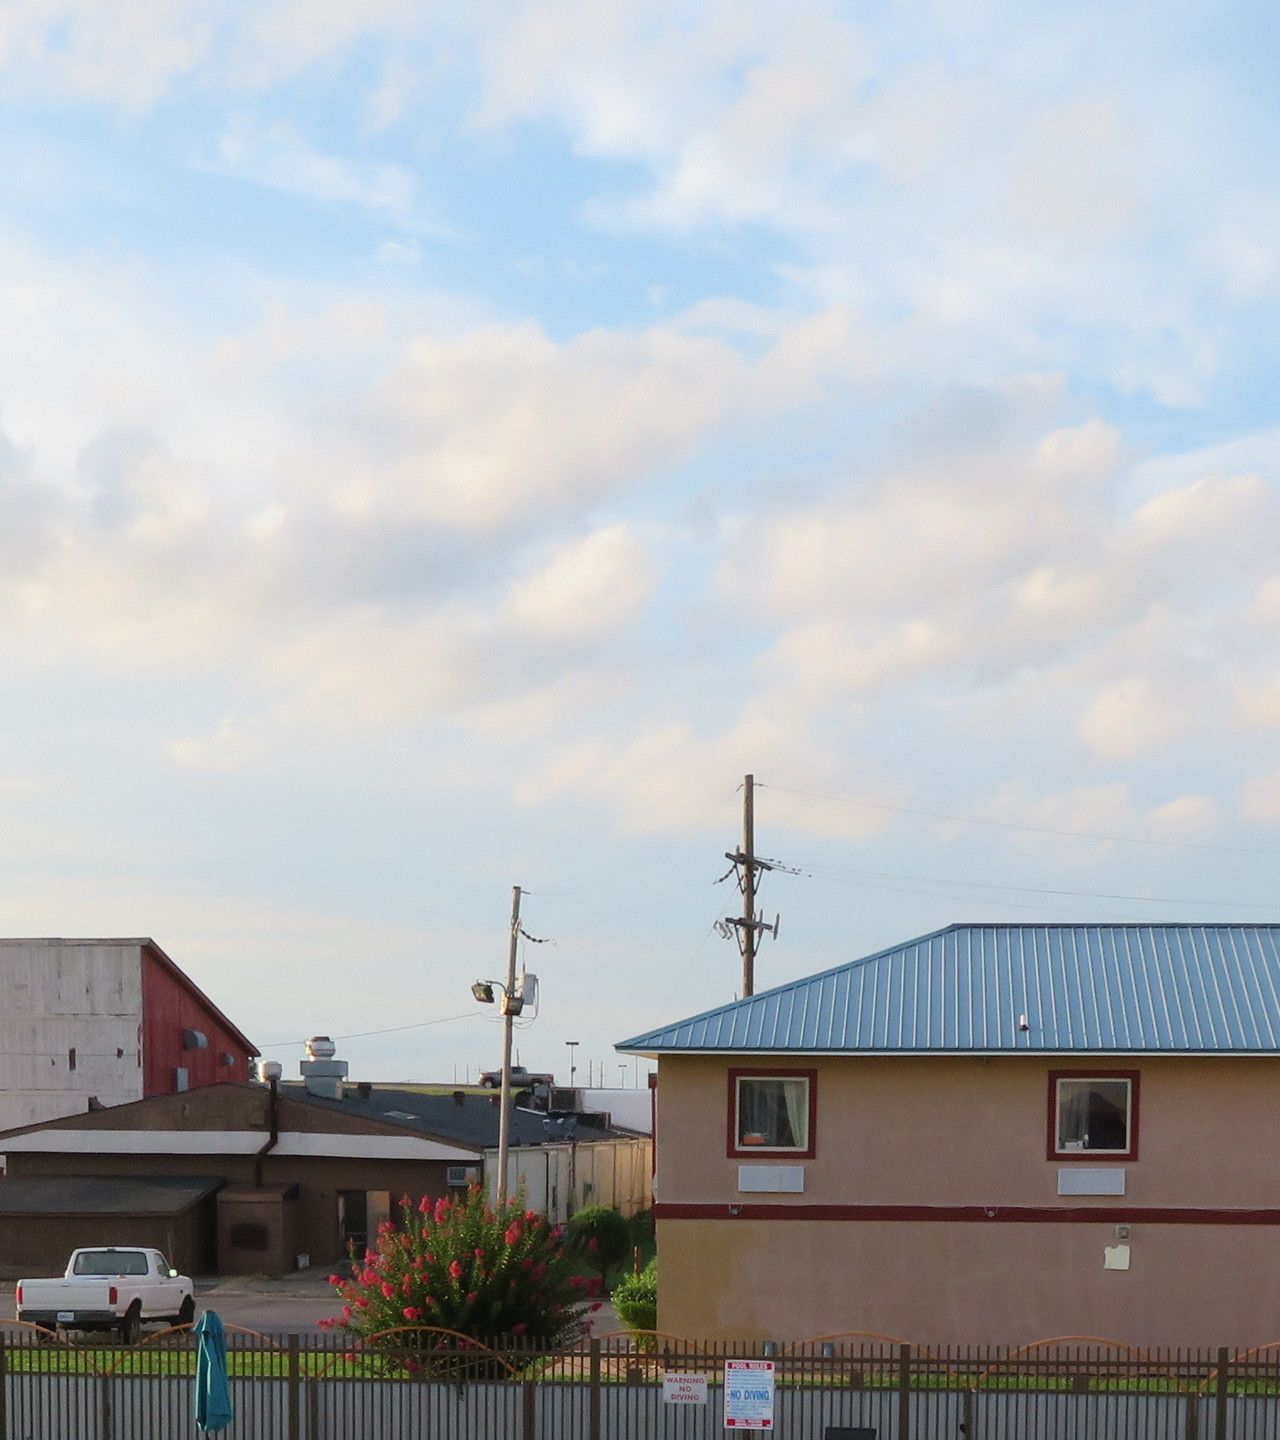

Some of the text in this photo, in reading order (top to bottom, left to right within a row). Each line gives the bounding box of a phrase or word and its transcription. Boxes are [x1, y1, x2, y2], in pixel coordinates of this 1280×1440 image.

[667, 1376, 705, 1385] WARNING
[671, 1393, 700, 1401] DIVING
[730, 1390, 770, 1401] NO DIVING
